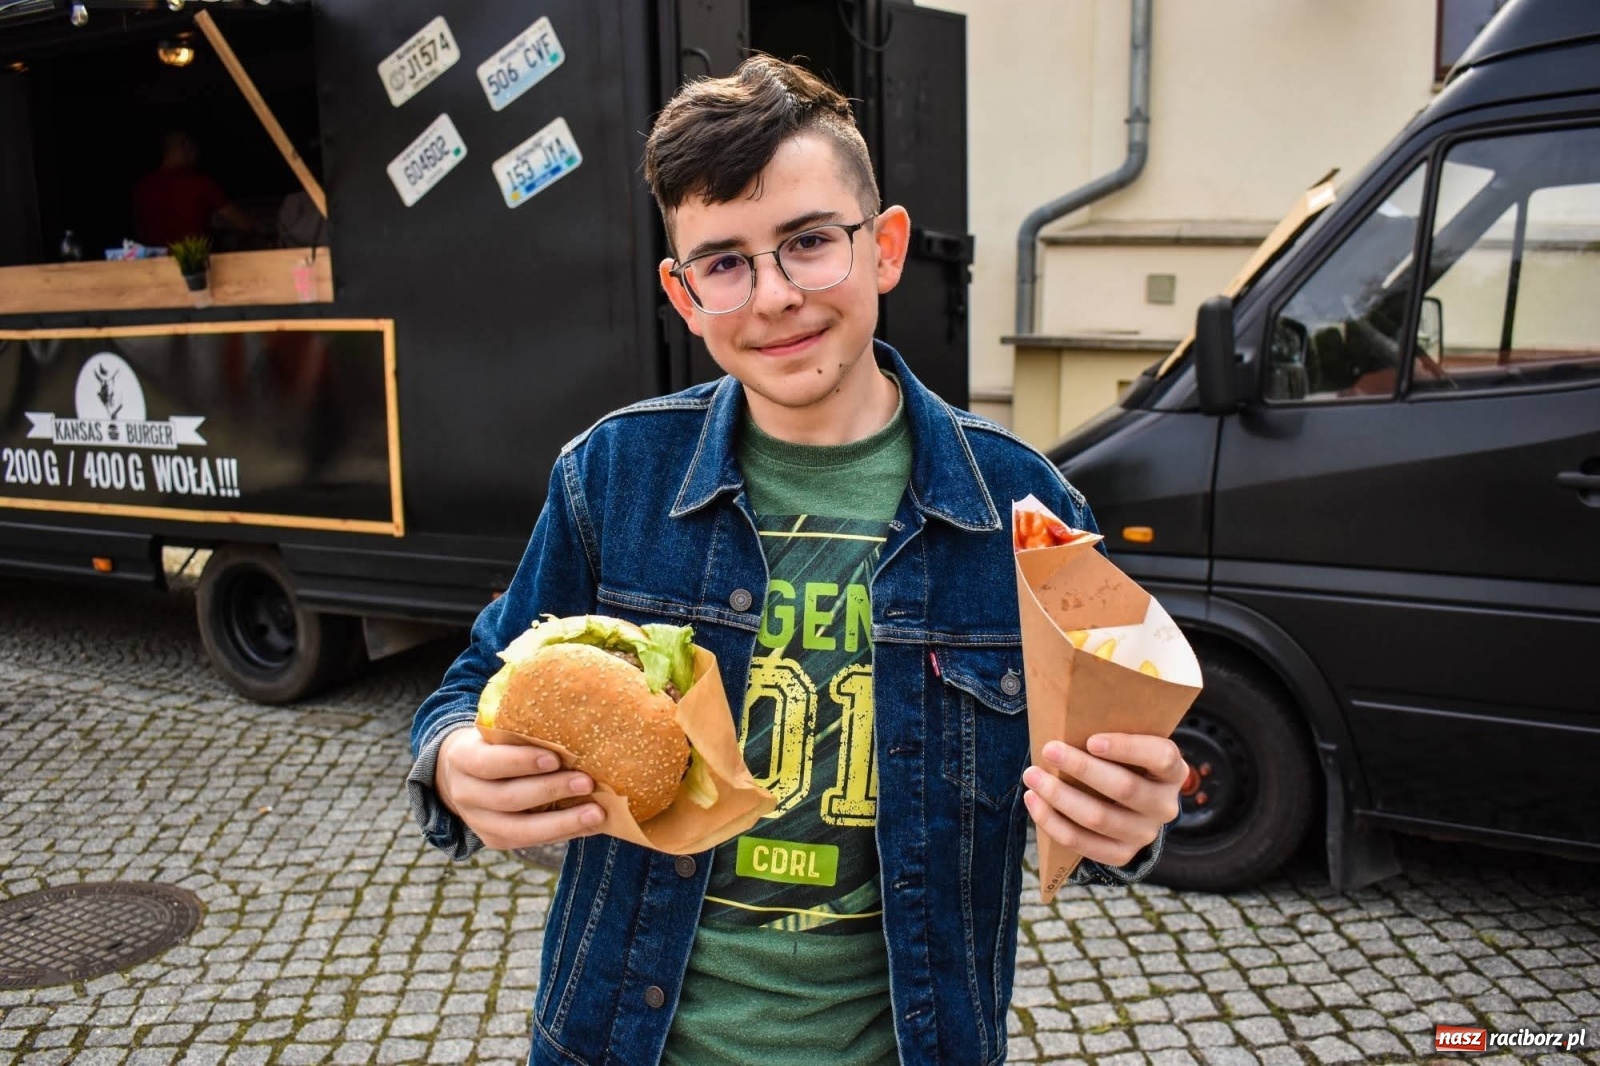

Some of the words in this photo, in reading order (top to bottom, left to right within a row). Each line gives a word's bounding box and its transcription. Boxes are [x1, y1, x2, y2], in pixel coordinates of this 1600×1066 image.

[487, 63, 520, 96] 506
[506, 159, 535, 192] 153
[54, 420, 103, 442] KANSAS
[126, 423, 174, 446] BURGER
[751, 844, 821, 879] CDRL
